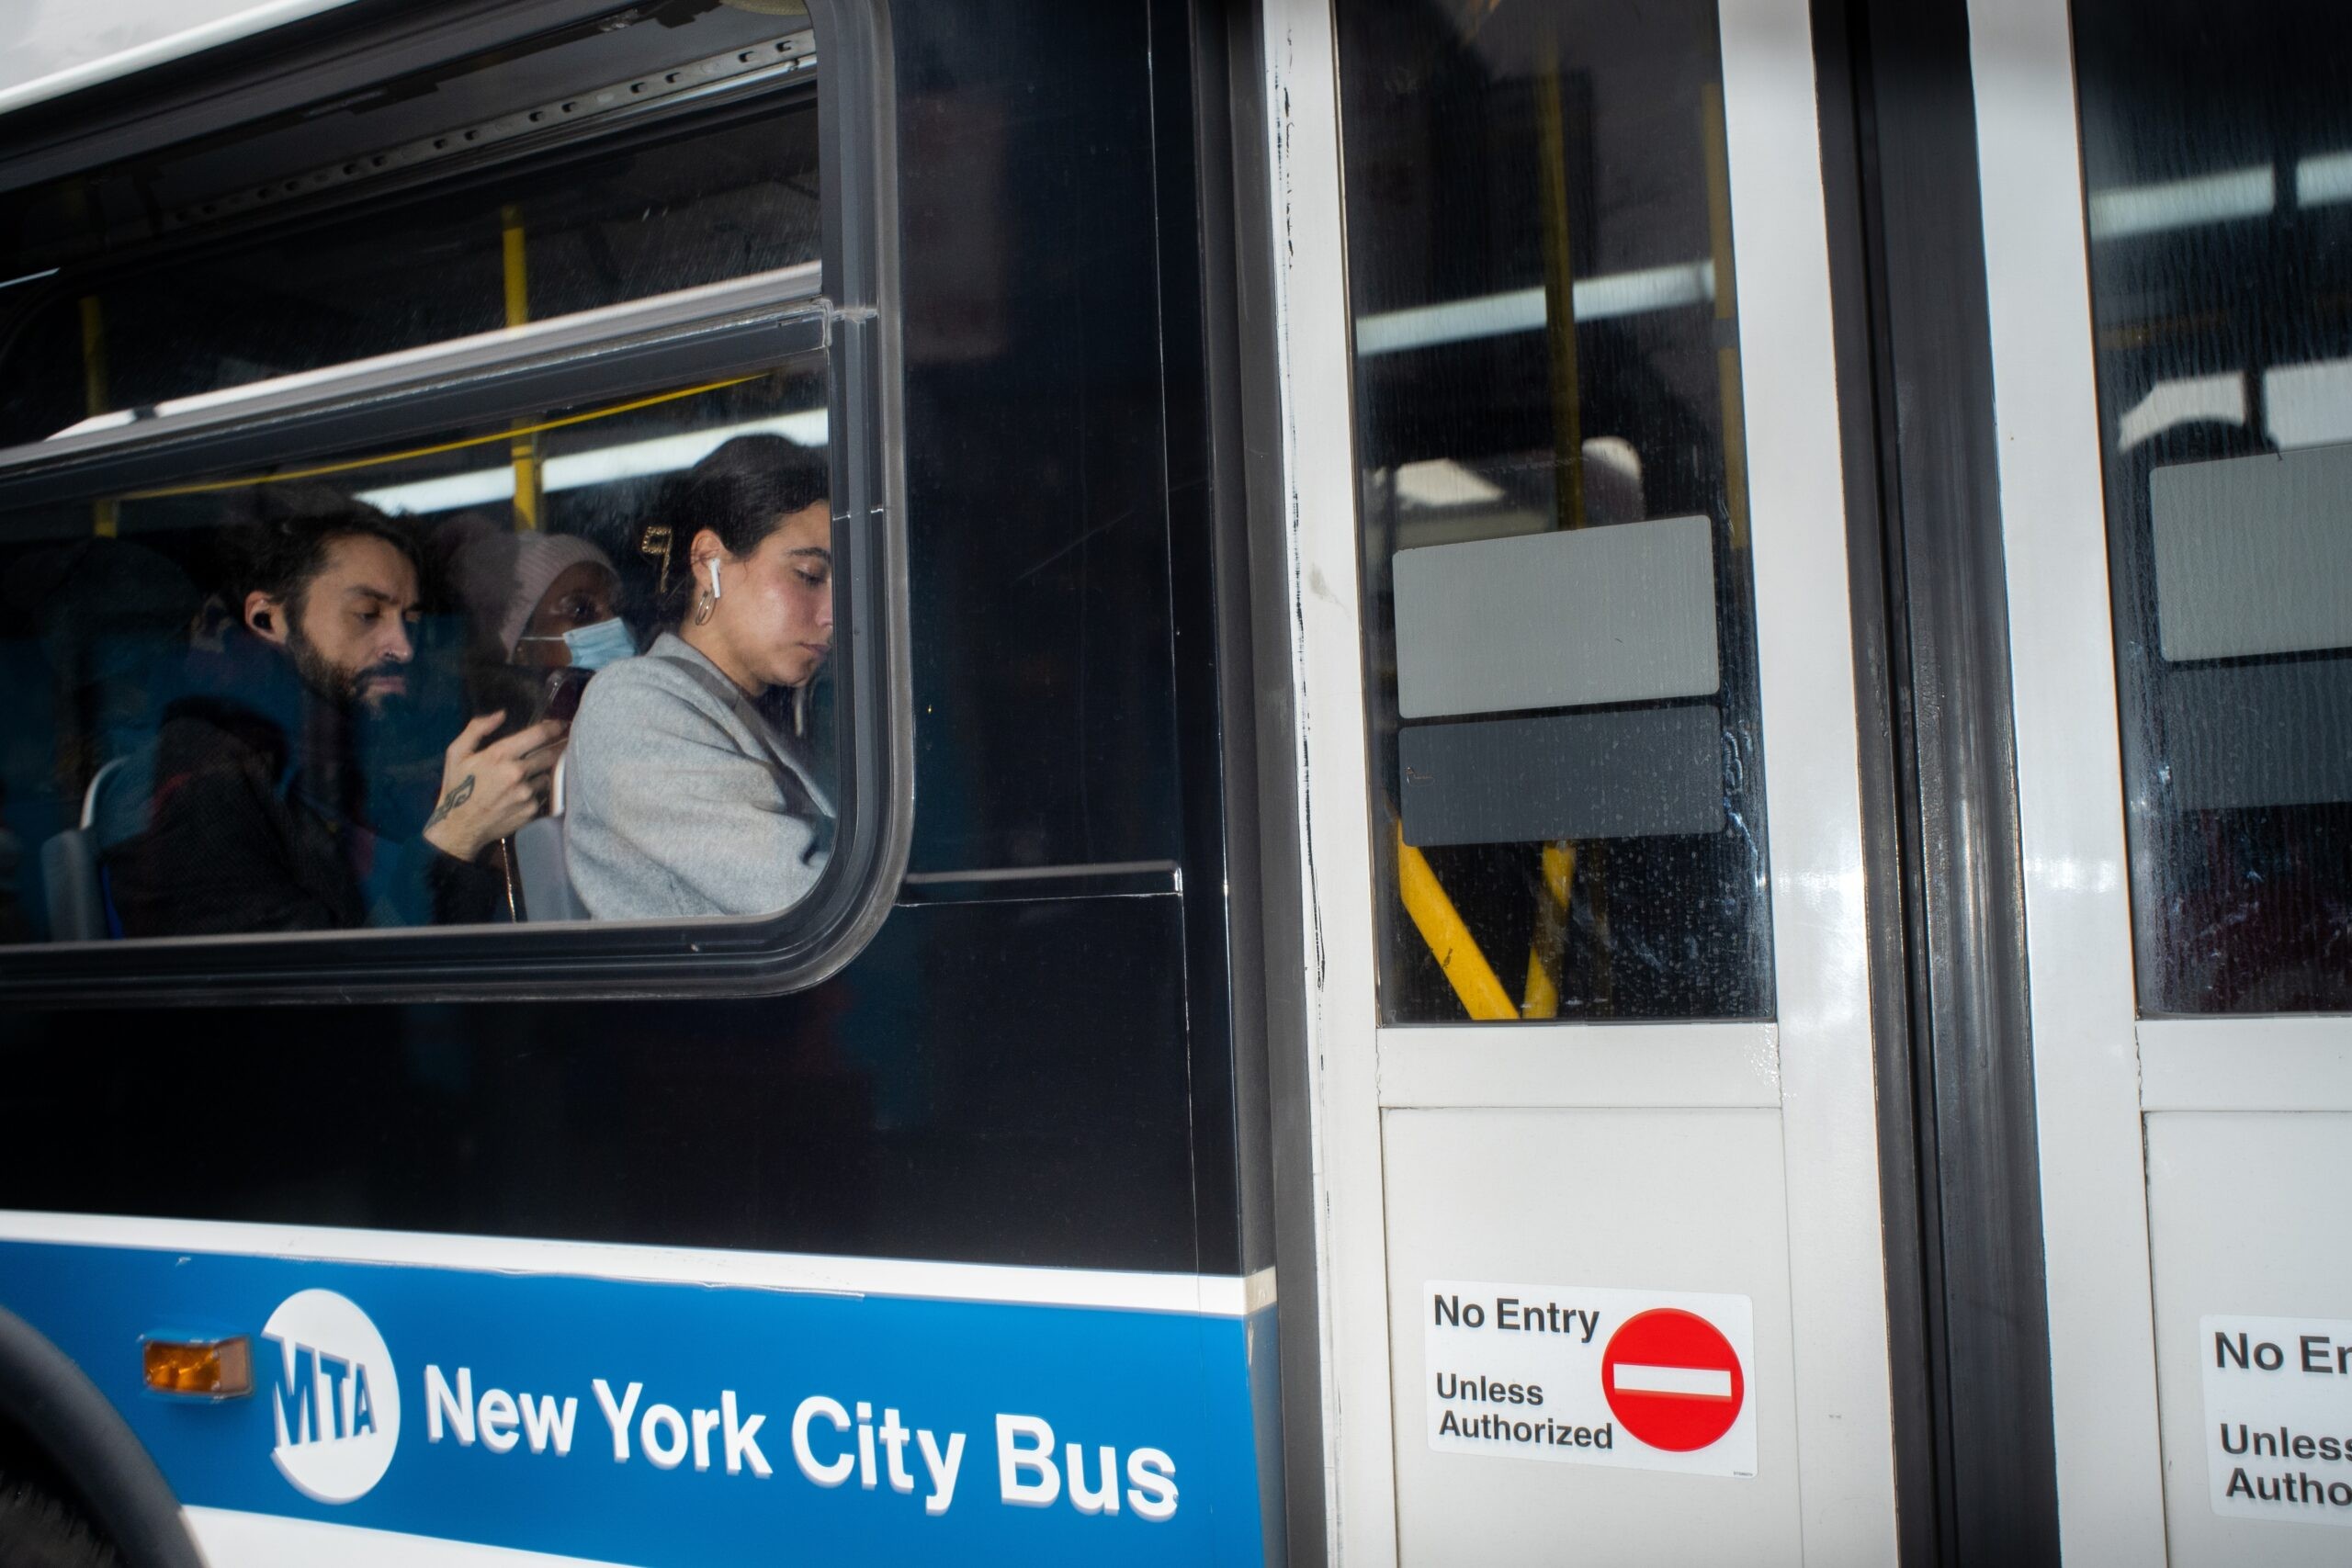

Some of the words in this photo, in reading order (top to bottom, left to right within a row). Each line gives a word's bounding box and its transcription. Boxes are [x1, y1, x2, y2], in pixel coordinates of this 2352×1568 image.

[1434, 1294, 1485, 1327] No
[1497, 1297, 1600, 1343] Entry
[2215, 1332, 2284, 1371] No
[273, 1334, 378, 1448] MTA
[1436, 1372, 1544, 1405] Unless
[424, 1364, 578, 1455] New
[592, 1378, 773, 1476] York
[791, 1394, 966, 1516] City
[996, 1413, 1179, 1522] Bus
[1439, 1410, 1613, 1450] Authorized
[2225, 1467, 2352, 1506] Autho
